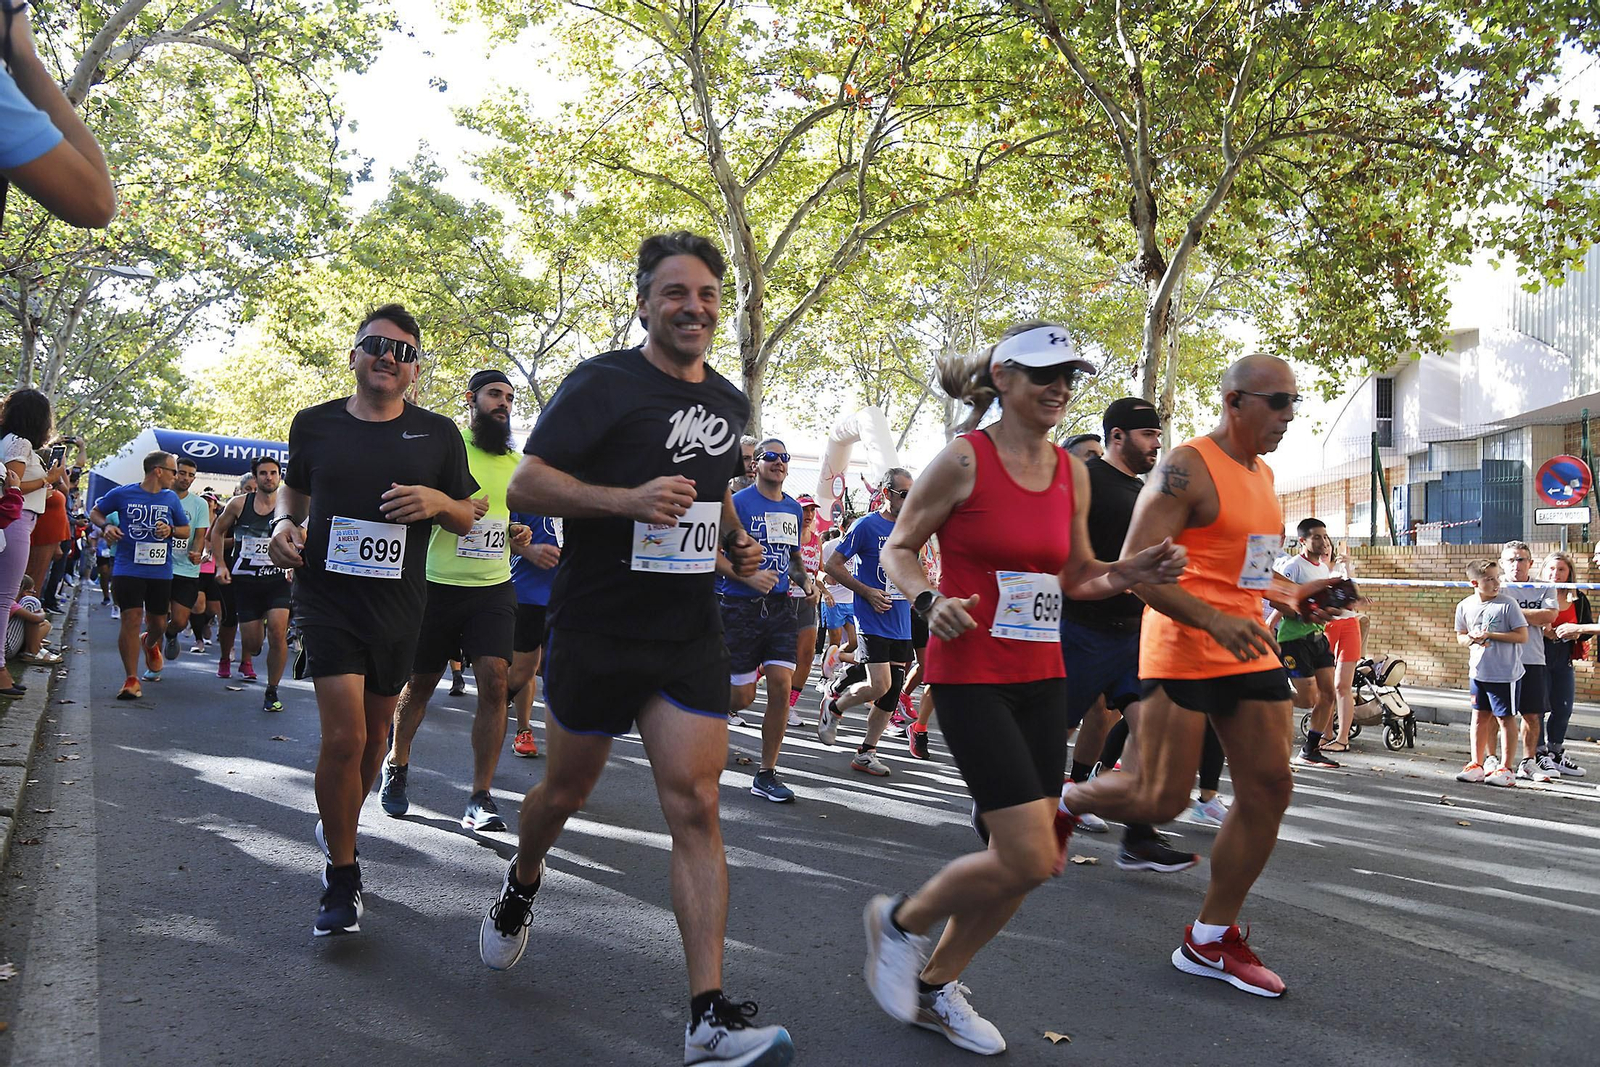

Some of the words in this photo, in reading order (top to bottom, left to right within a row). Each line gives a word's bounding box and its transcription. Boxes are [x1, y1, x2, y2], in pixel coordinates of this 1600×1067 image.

[483, 530, 505, 548] 123
[678, 521, 717, 553] 700
[782, 521, 798, 537] 664
[149, 548, 166, 559] 652
[359, 536, 402, 563] 699
[1033, 591, 1060, 622] 698
